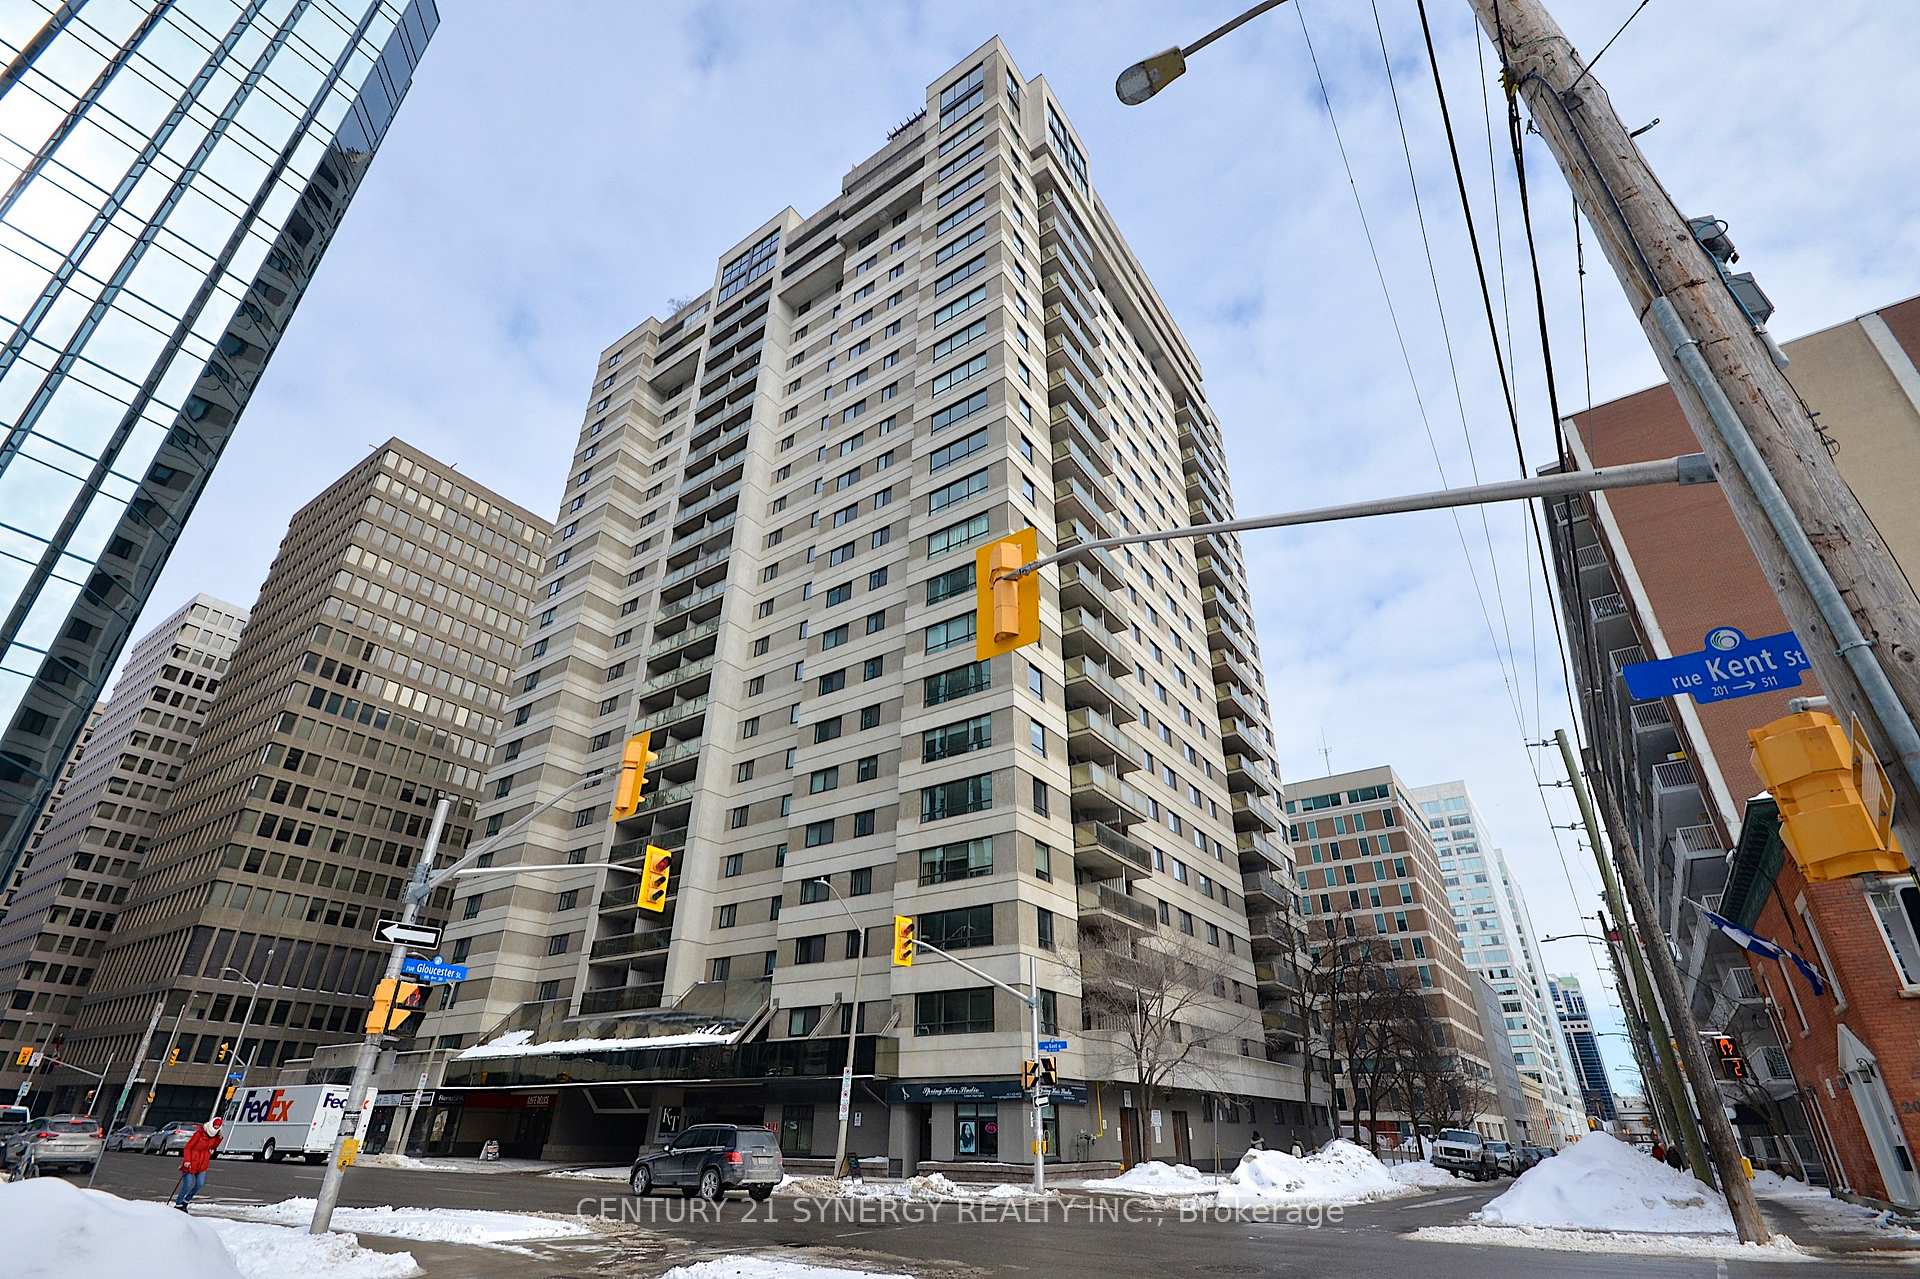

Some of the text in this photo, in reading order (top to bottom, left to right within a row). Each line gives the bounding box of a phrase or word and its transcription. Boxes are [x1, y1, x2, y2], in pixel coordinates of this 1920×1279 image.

[1672, 648, 1806, 689] rue Kent St
[1711, 676, 1778, 697] 201 511
[417, 964, 455, 977] Gloucester
[1732, 1060, 1742, 1076] 2
[922, 1087, 943, 1097] Spring
[959, 1086, 980, 1094] Studio
[238, 1090, 295, 1122] FedEx
